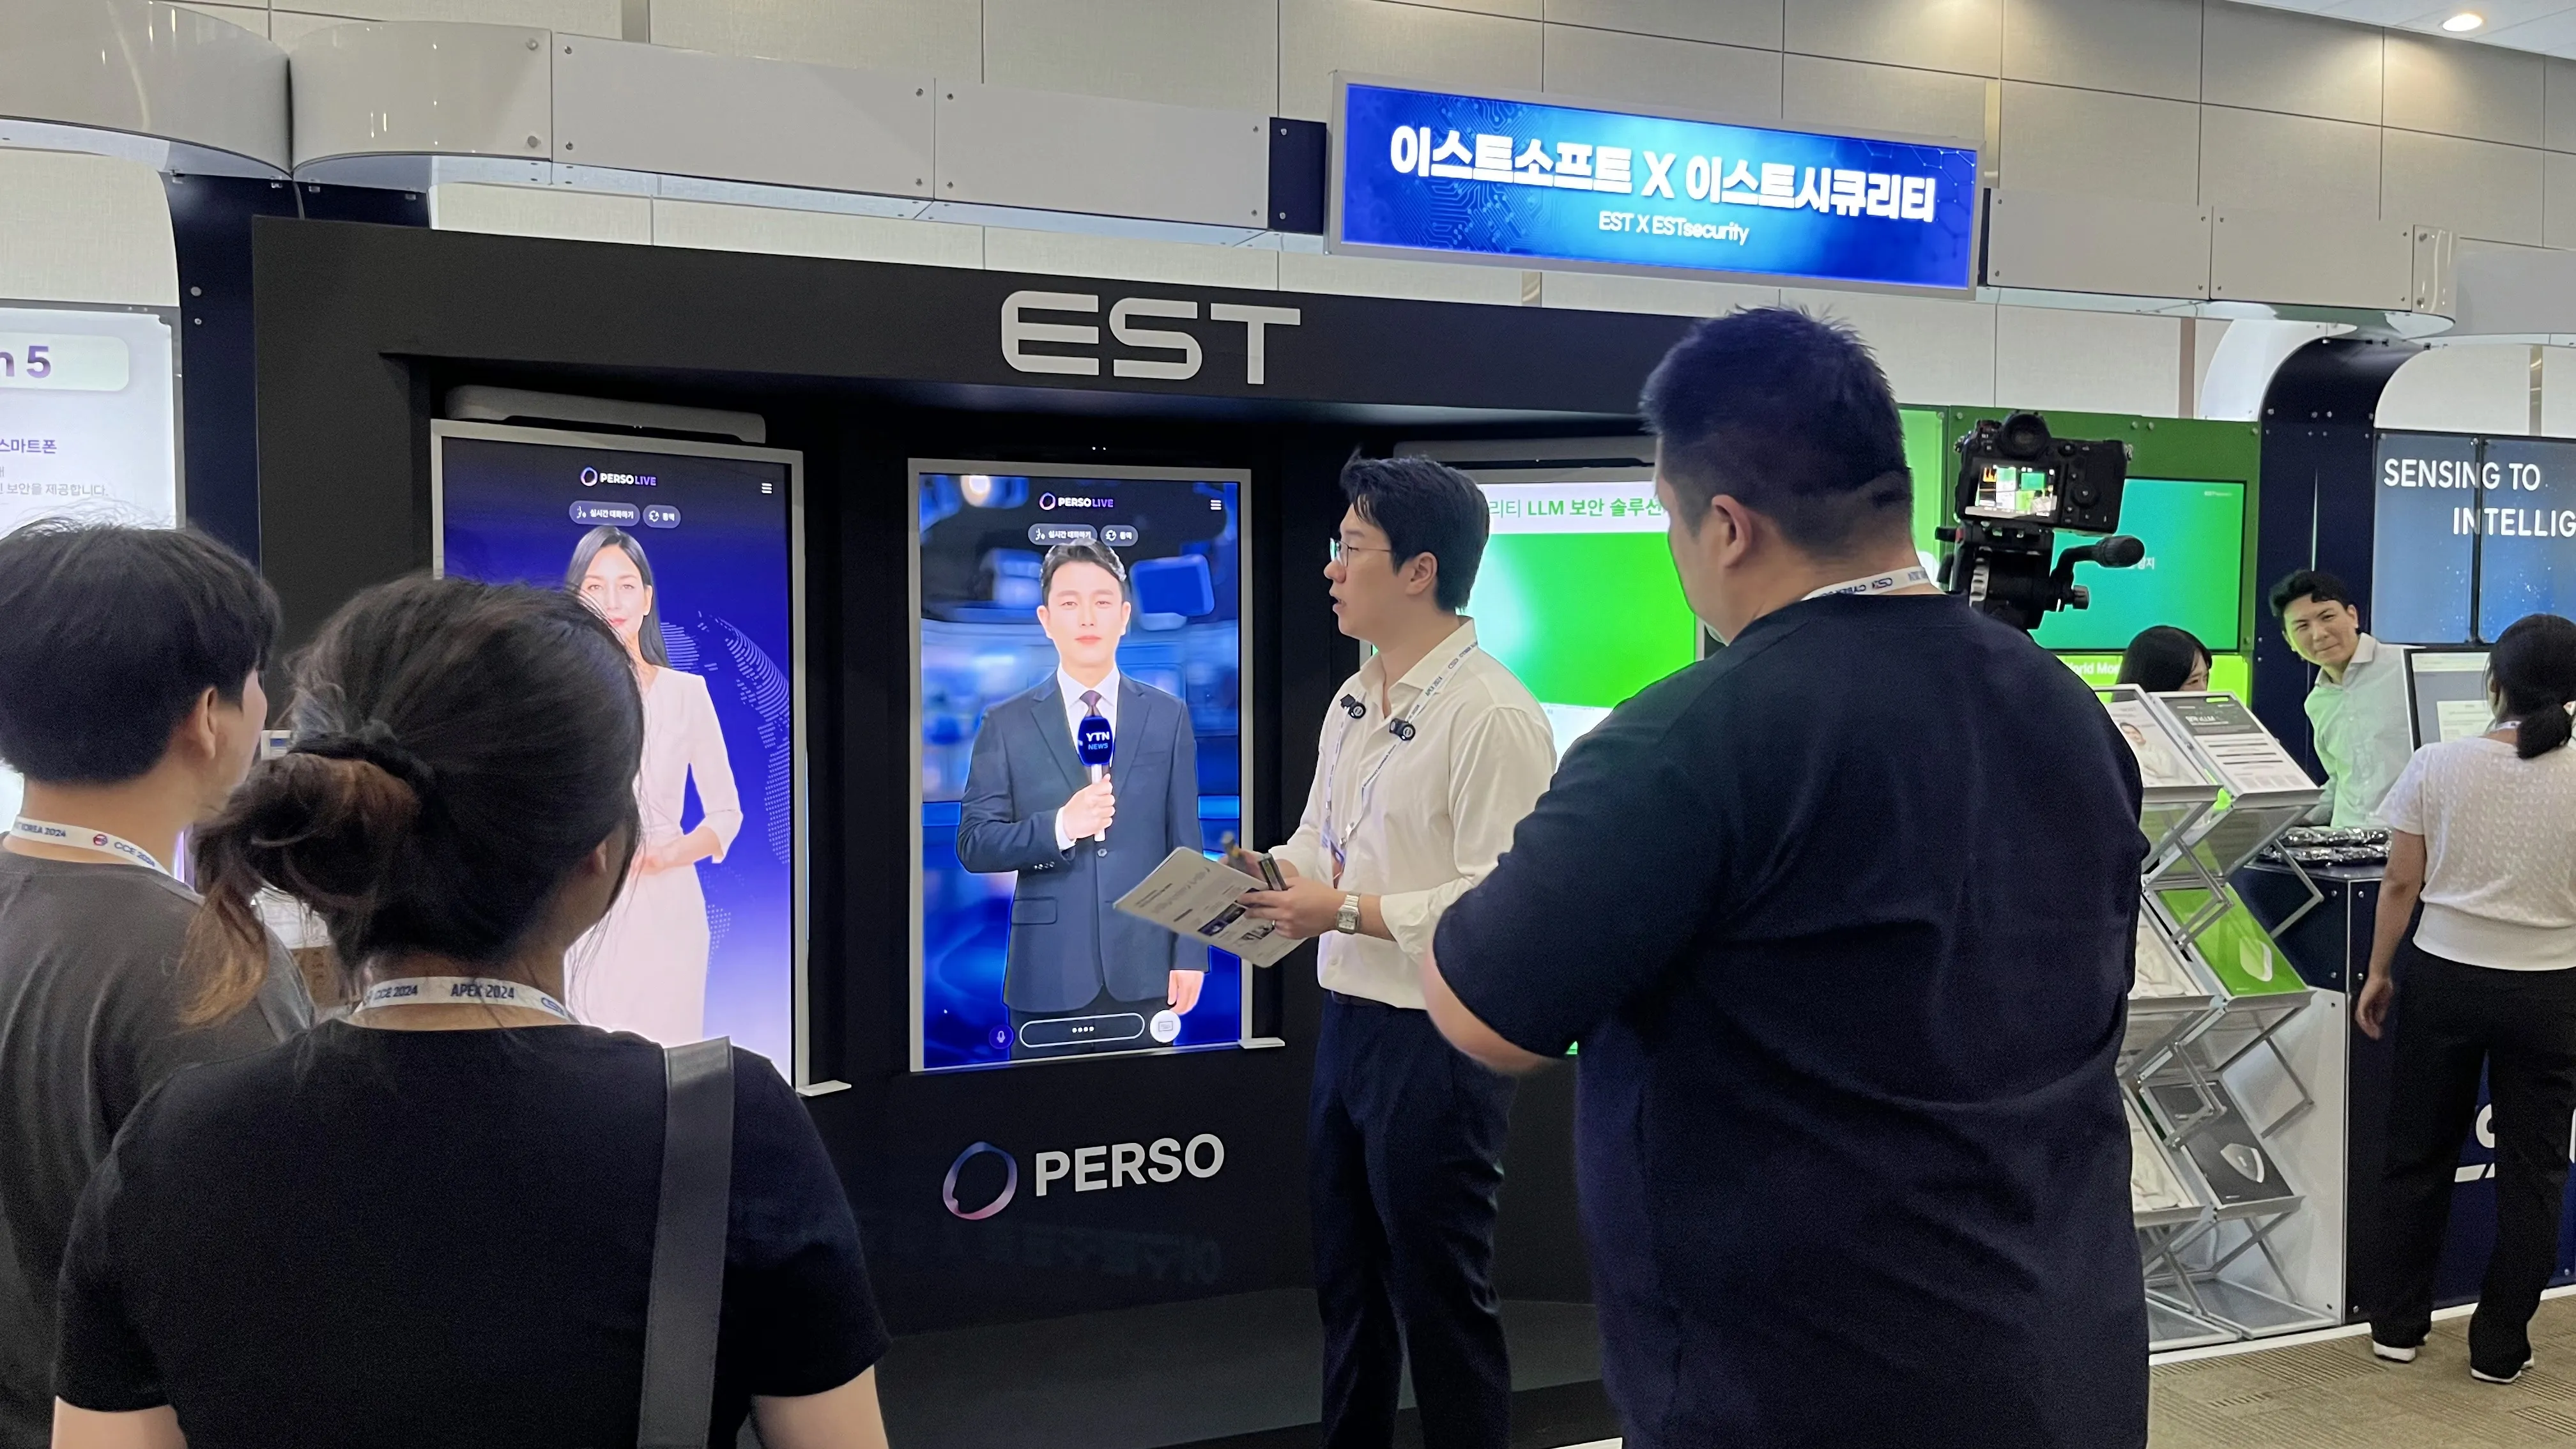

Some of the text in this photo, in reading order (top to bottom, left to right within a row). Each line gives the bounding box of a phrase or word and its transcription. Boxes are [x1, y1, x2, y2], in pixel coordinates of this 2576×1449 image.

[1390, 125, 1936, 222] 이스트소프트 X 이스트시큐리티
[1599, 211, 1749, 245] EST X ESTsecurity
[1001, 290, 1301, 385] EST
[26, 345, 51, 378] 5
[0, 438, 57, 454] 스마트폰
[599, 472, 657, 486] PERSO LIVE
[2384, 458, 2541, 491] SENSING TO
[1058, 497, 1114, 508] PERSO LIVE
[1528, 500, 1564, 516] LLM
[1570, 498, 1604, 516] 보안
[2453, 507, 2576, 537] INTELLIG
[1086, 732, 1110, 742] YTN
[393, 985, 418, 997] 2024
[486, 985, 515, 999] 2024
[1036, 1133, 1225, 1197] PERSO
